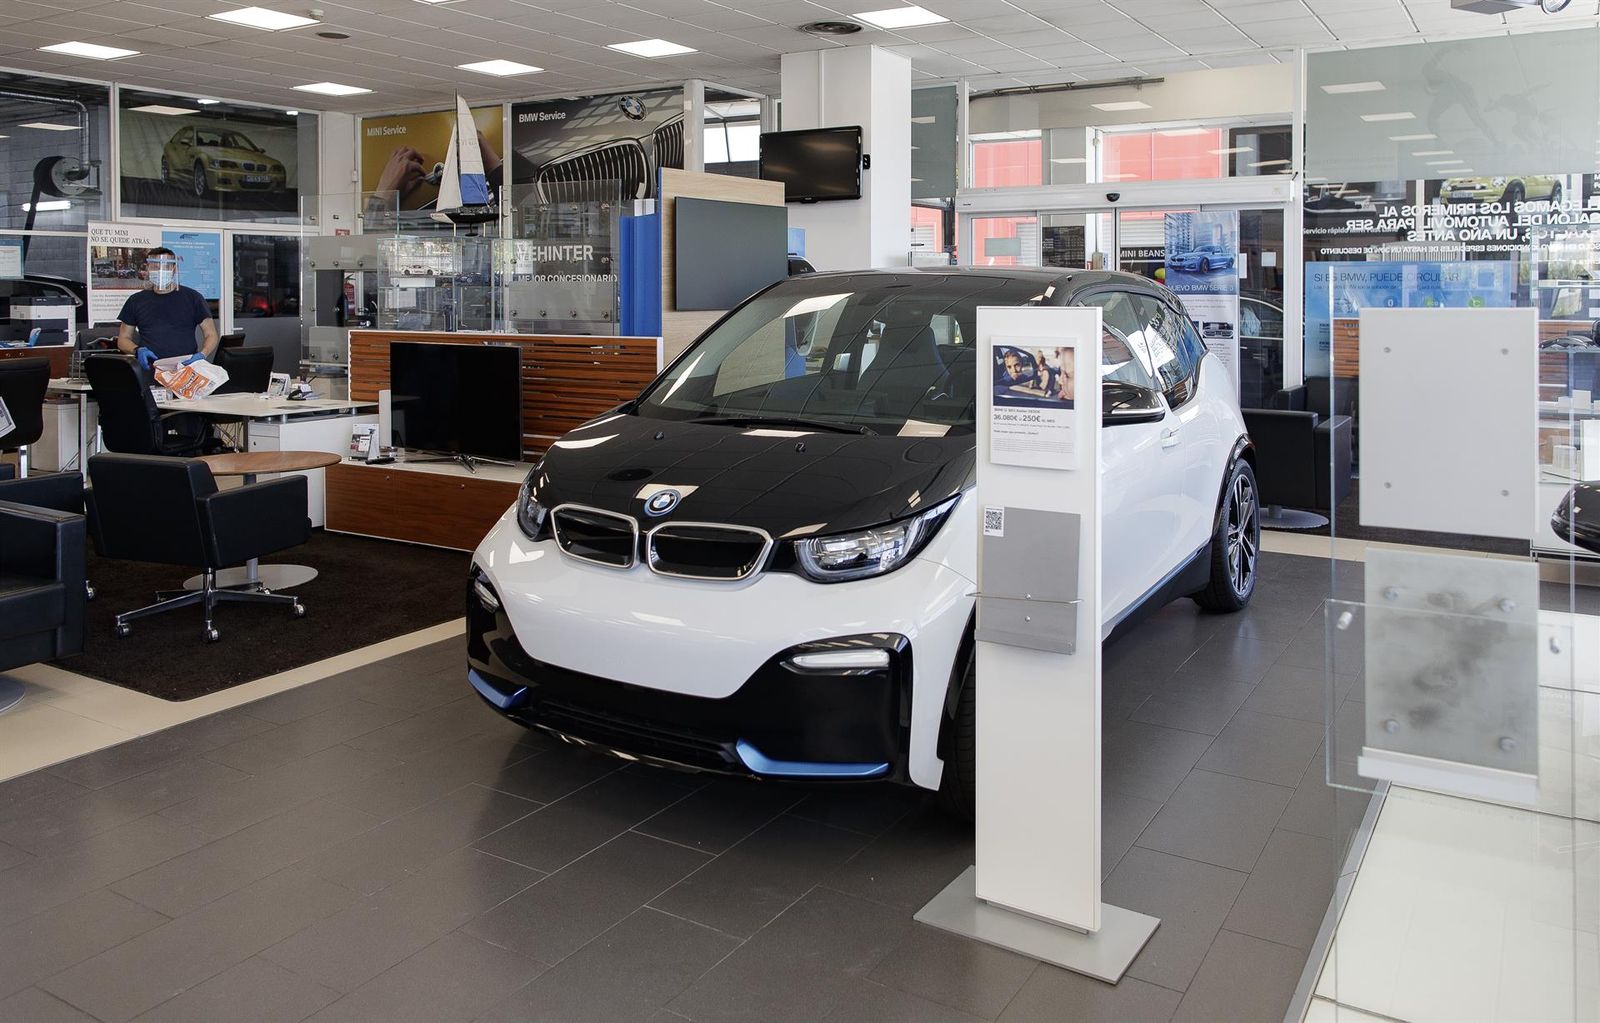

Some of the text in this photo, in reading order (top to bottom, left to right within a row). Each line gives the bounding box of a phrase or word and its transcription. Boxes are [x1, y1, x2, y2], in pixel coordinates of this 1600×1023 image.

[519, 110, 566, 123] BMW Service
[367, 125, 407, 137] MINI Service
[91, 228, 104, 237] QUE
[110, 237, 130, 245] QUEDE
[1138, 249, 1165, 258] BEANS
[547, 274, 618, 283] CONCESIONARIO
[1314, 273, 1323, 282] SI
[1340, 273, 1367, 283] BMW,
[1369, 272, 1403, 282] PUEDE
[1022, 414, 1041, 422] 250€
